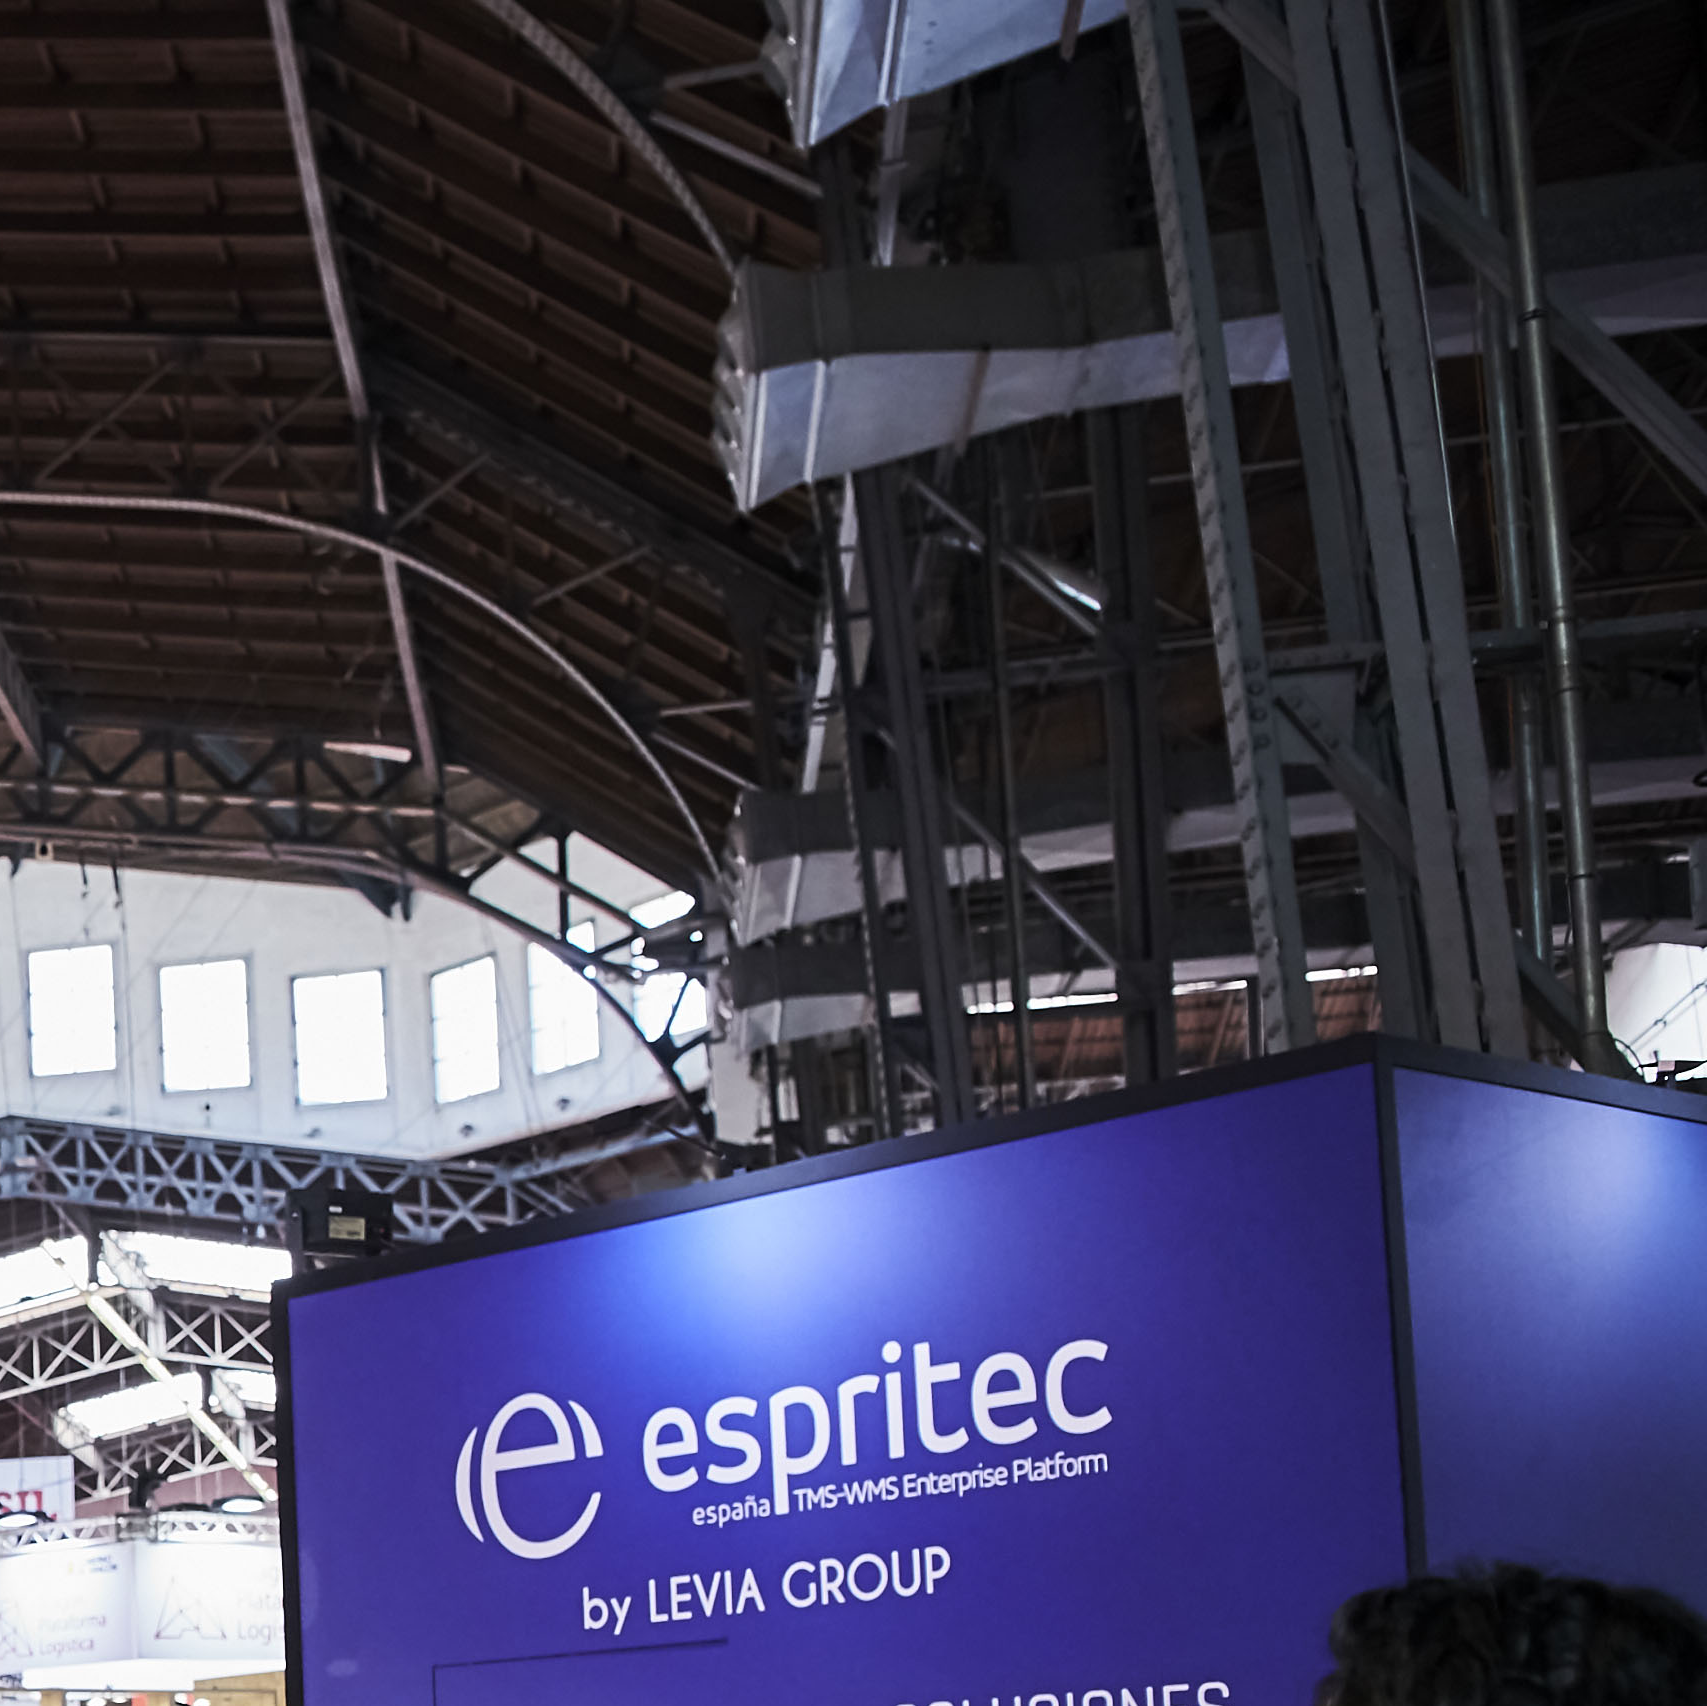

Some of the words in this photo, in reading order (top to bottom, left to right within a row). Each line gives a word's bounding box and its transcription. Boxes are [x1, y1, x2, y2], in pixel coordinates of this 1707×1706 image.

[643, 1340, 1113, 1515] espritec
[692, 1493, 771, 1528] españa
[793, 1474, 900, 1514] TMS-WMS
[902, 1461, 1009, 1499] Enterprise
[1012, 1450, 1109, 1485] Platform
[582, 1585, 632, 1635] by
[648, 1566, 766, 1624] LEVIA
[781, 1544, 952, 1609] GROUP
